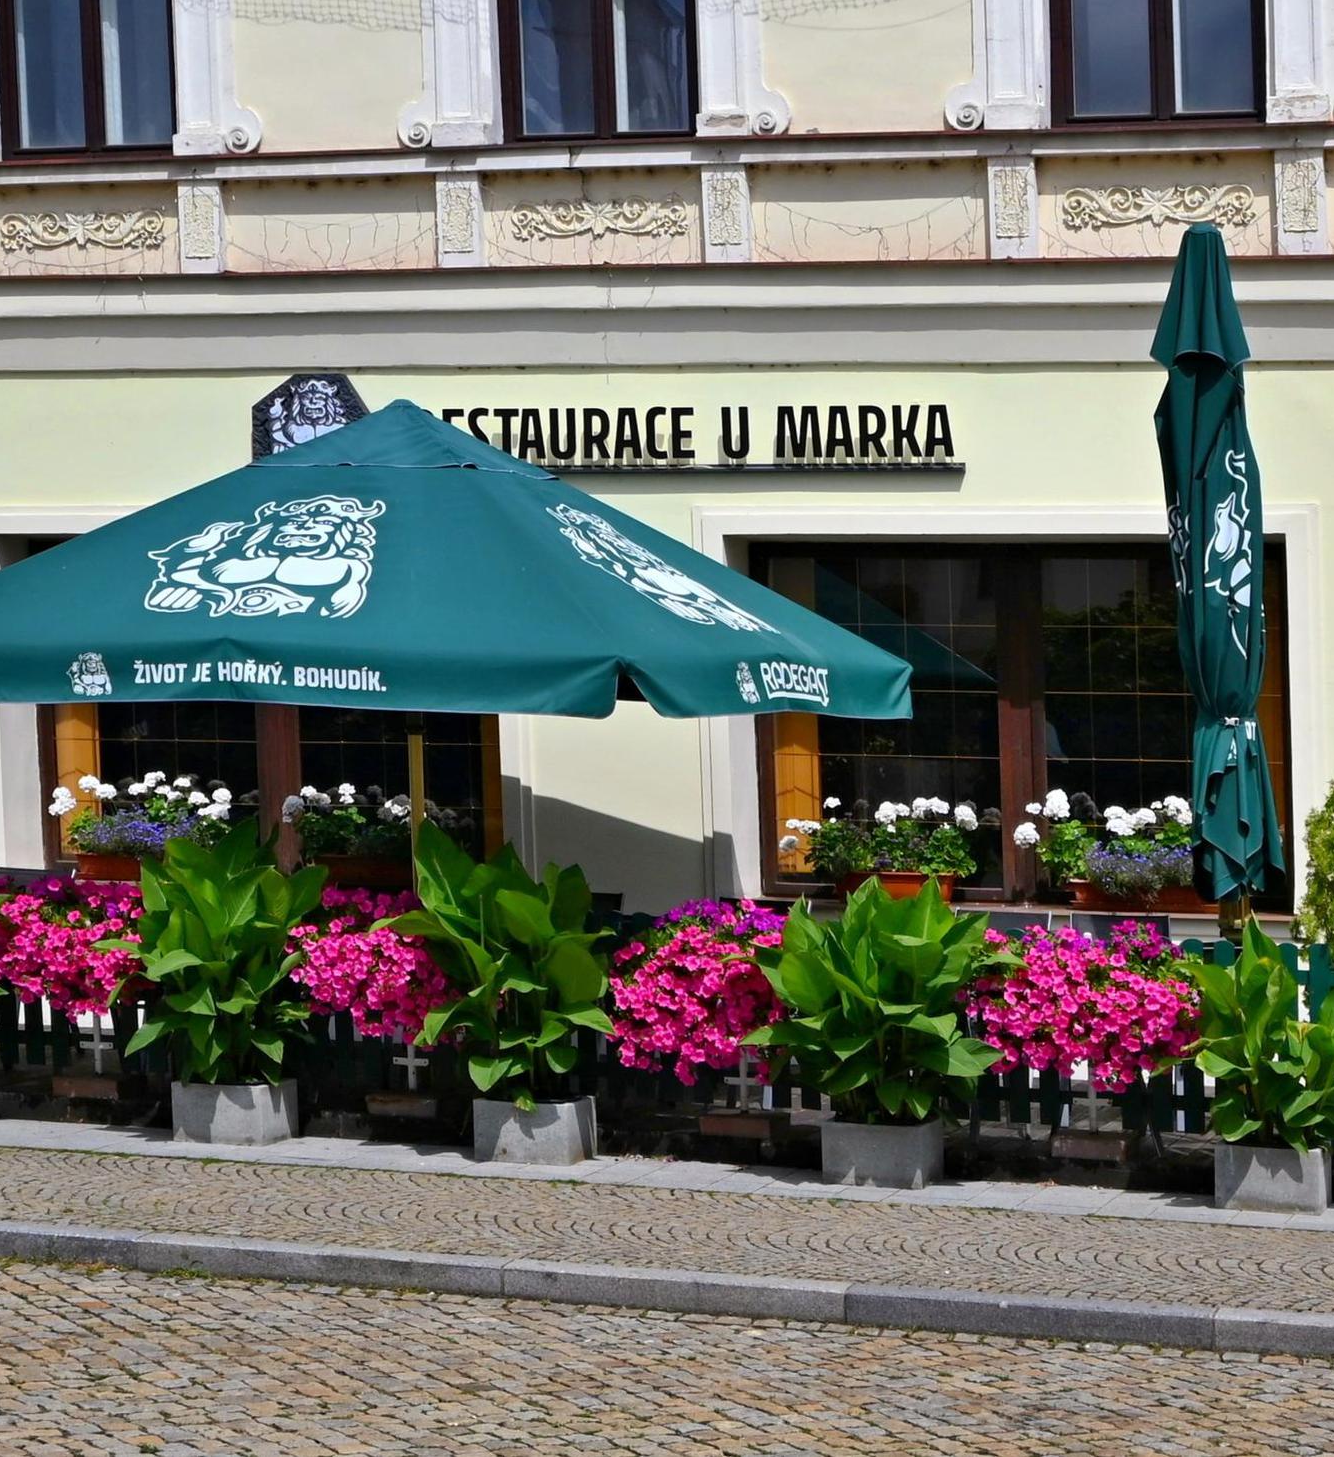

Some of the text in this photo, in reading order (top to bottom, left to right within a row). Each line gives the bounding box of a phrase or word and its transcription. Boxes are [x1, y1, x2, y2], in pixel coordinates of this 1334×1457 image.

[423, 404, 955, 460] STAURACE U MARKA
[133, 658, 387, 692] ŽIVOT JE HOŘKÝ. BOHUDÍK.
[760, 661, 829, 706] RADEGAST
